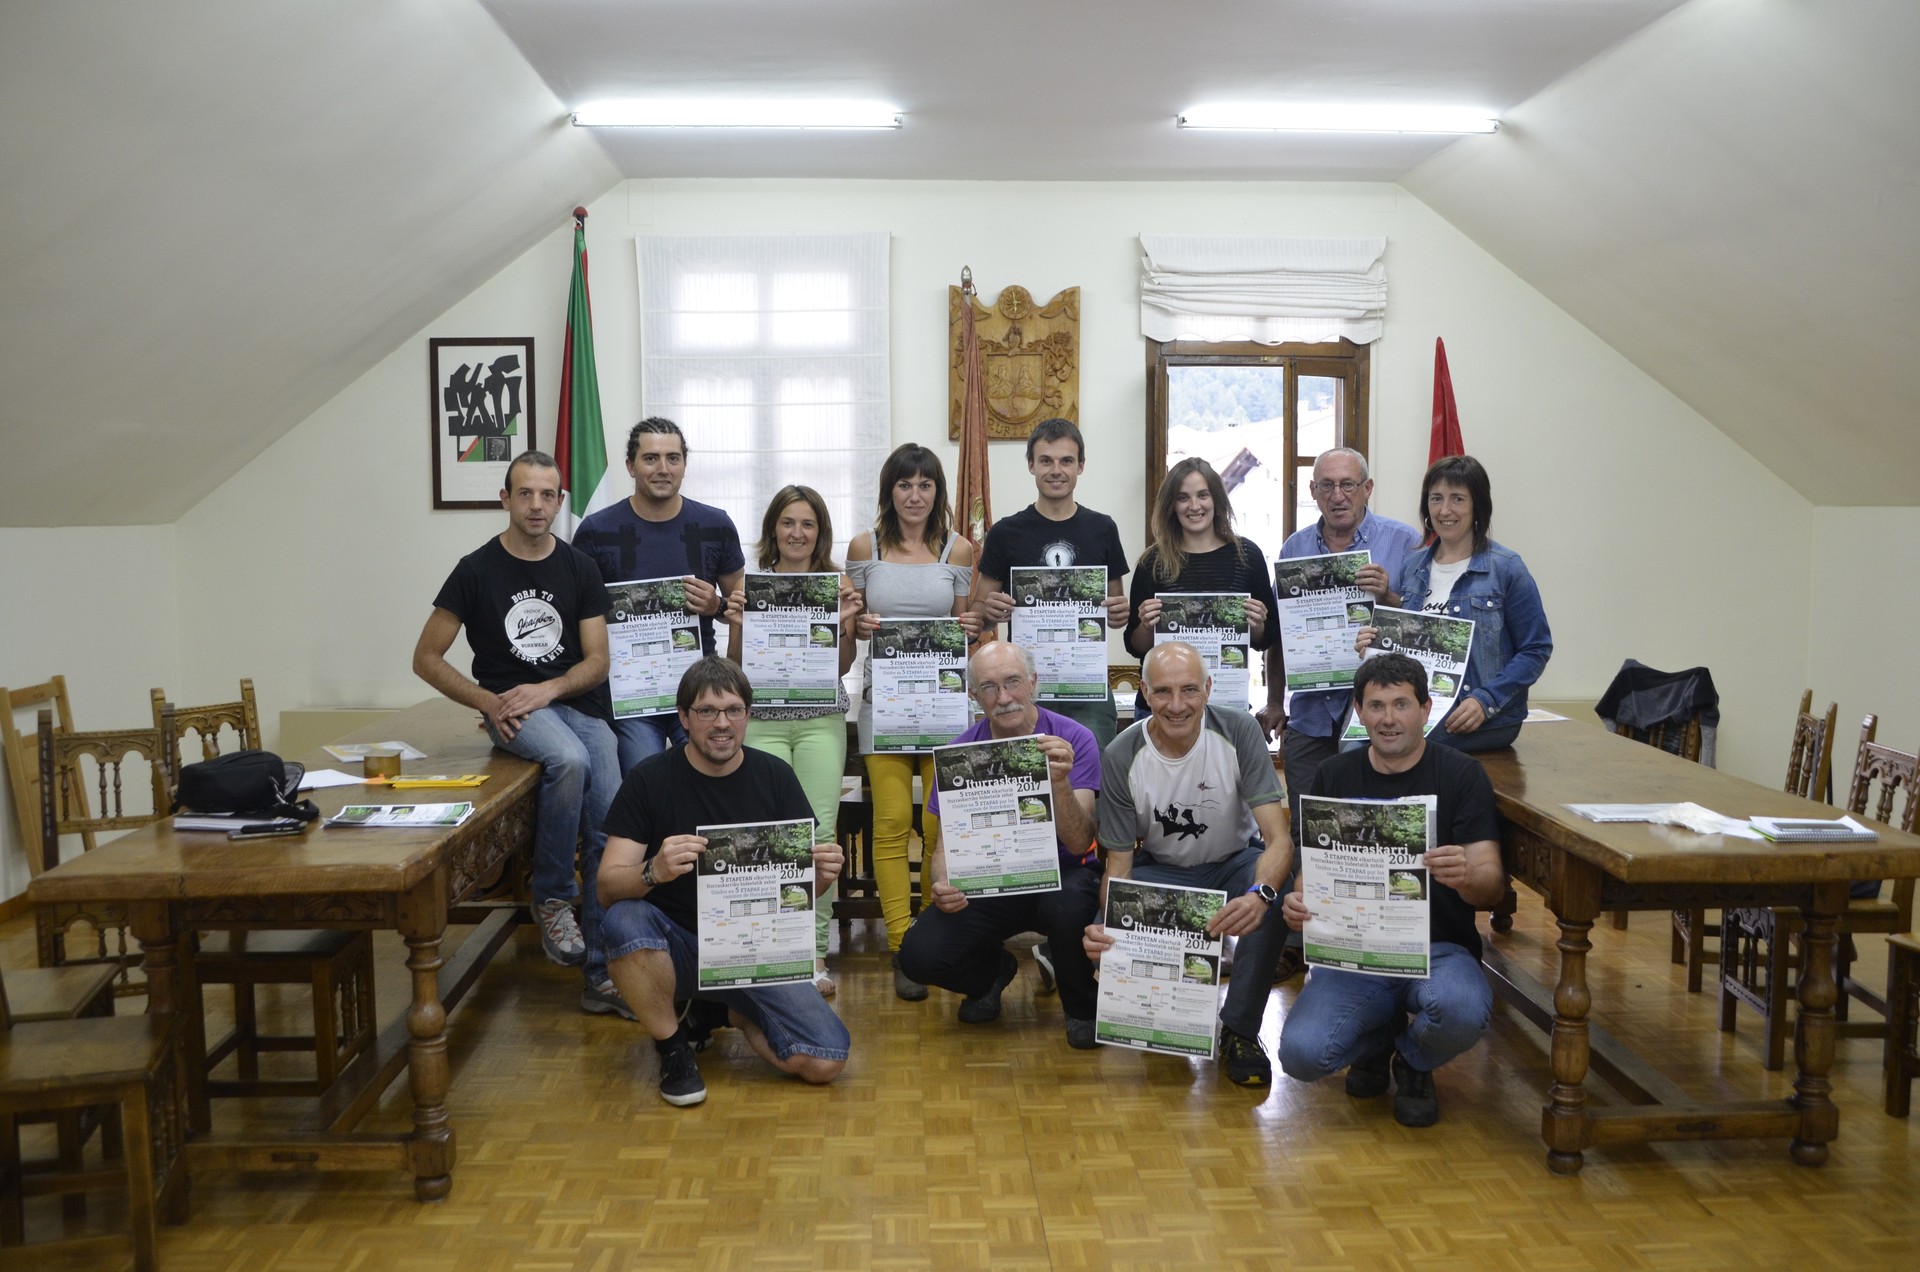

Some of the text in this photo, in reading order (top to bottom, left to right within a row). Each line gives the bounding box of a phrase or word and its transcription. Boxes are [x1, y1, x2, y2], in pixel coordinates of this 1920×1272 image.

[511, 589, 554, 604] BORN TO
[1301, 586, 1359, 597] Iturraskarri
[1345, 590, 1366, 600] 2017
[768, 604, 825, 612] Iturraskarri
[1036, 598, 1092, 607] Iturraskarri
[627, 608, 684, 623] Iturraskarri
[1078, 606, 1099, 614] 2017
[670, 616, 691, 625] 2017
[1179, 625, 1235, 634] Iturraskarri
[547, 644, 564, 661] WIN
[896, 649, 953, 659] Iturraskarri
[1392, 643, 1453, 661] Iturraskarri
[939, 657, 959, 665] 2017
[1435, 659, 1458, 670] 2017
[965, 772, 1033, 789] Iturraskarri
[1016, 781, 1041, 792] 2017
[1332, 841, 1408, 855] Iturraskarri
[1389, 854, 1417, 865] 2017
[728, 859, 797, 875] Iturraskarri
[780, 868, 805, 880] 2017
[1134, 921, 1204, 940] Iturraskarri
[1185, 938, 1211, 951] 2017
